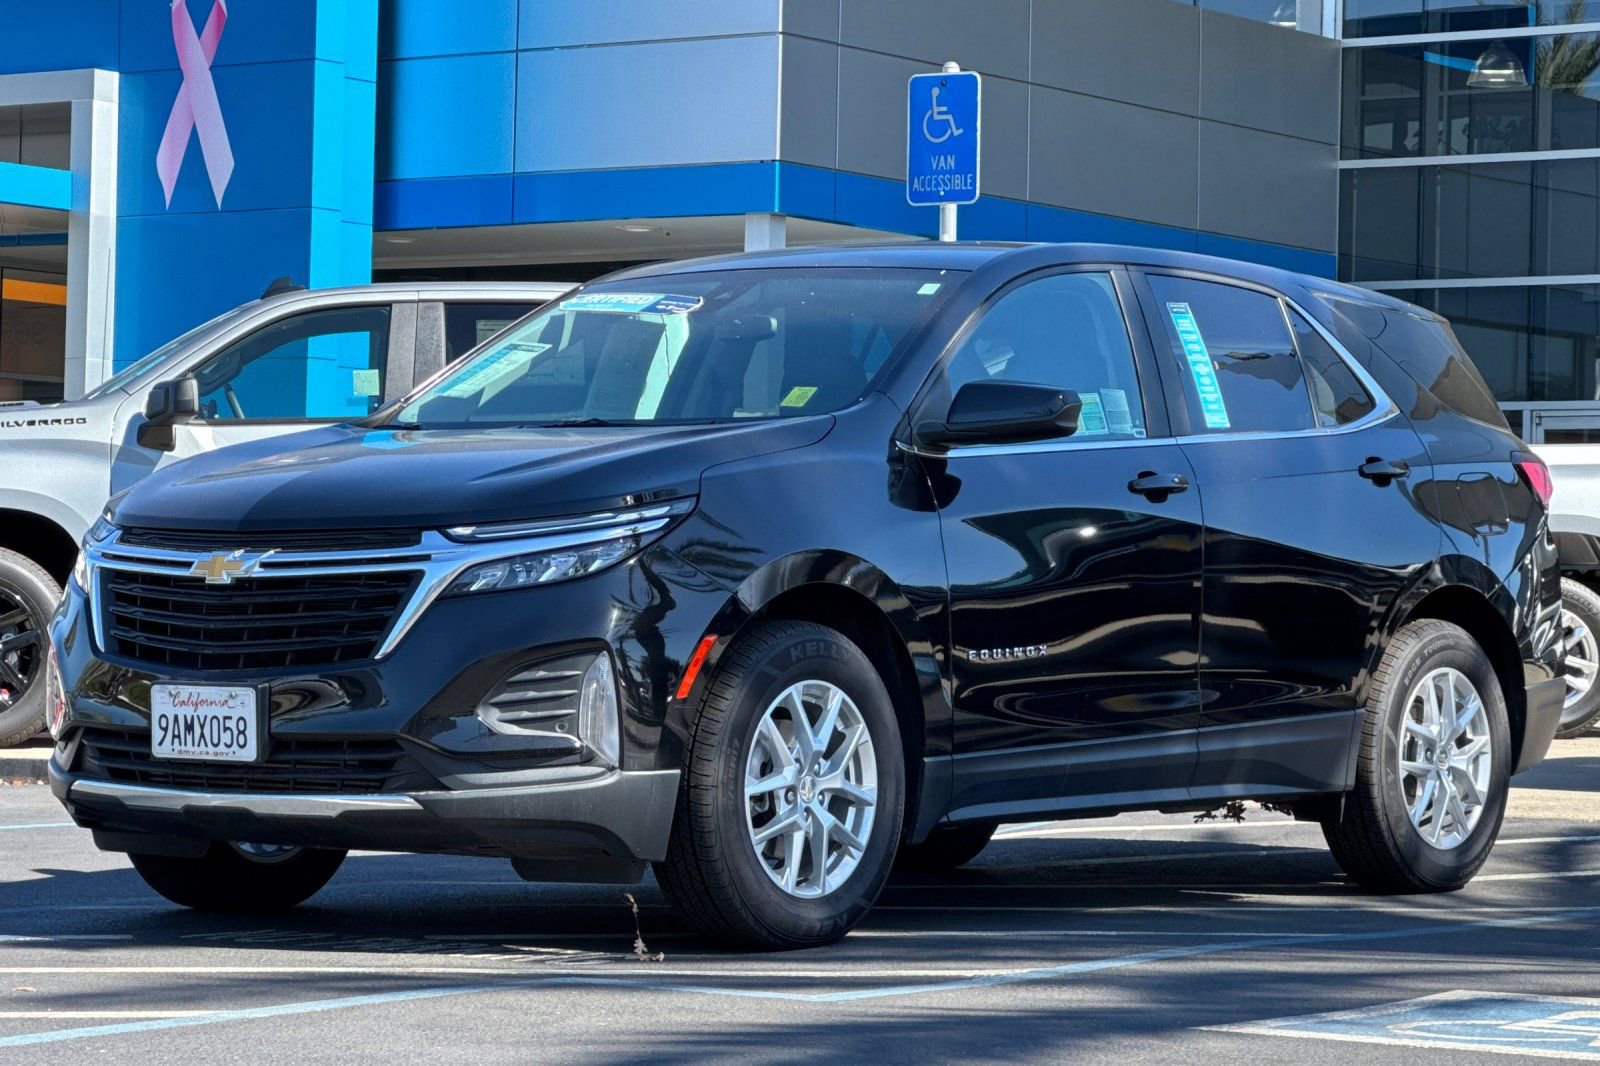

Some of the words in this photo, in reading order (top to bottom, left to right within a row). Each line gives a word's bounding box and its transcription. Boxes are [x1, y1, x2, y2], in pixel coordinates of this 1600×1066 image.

[931, 154, 955, 171] VAN
[912, 174, 974, 192] ACCESSIBLE
[0, 417, 87, 428] ILVERADO
[968, 645, 1047, 661] EQUINOX
[172, 691, 235, 713] California
[157, 713, 248, 749] 9AMX058
[177, 749, 230, 757] dmv.ca.gov
